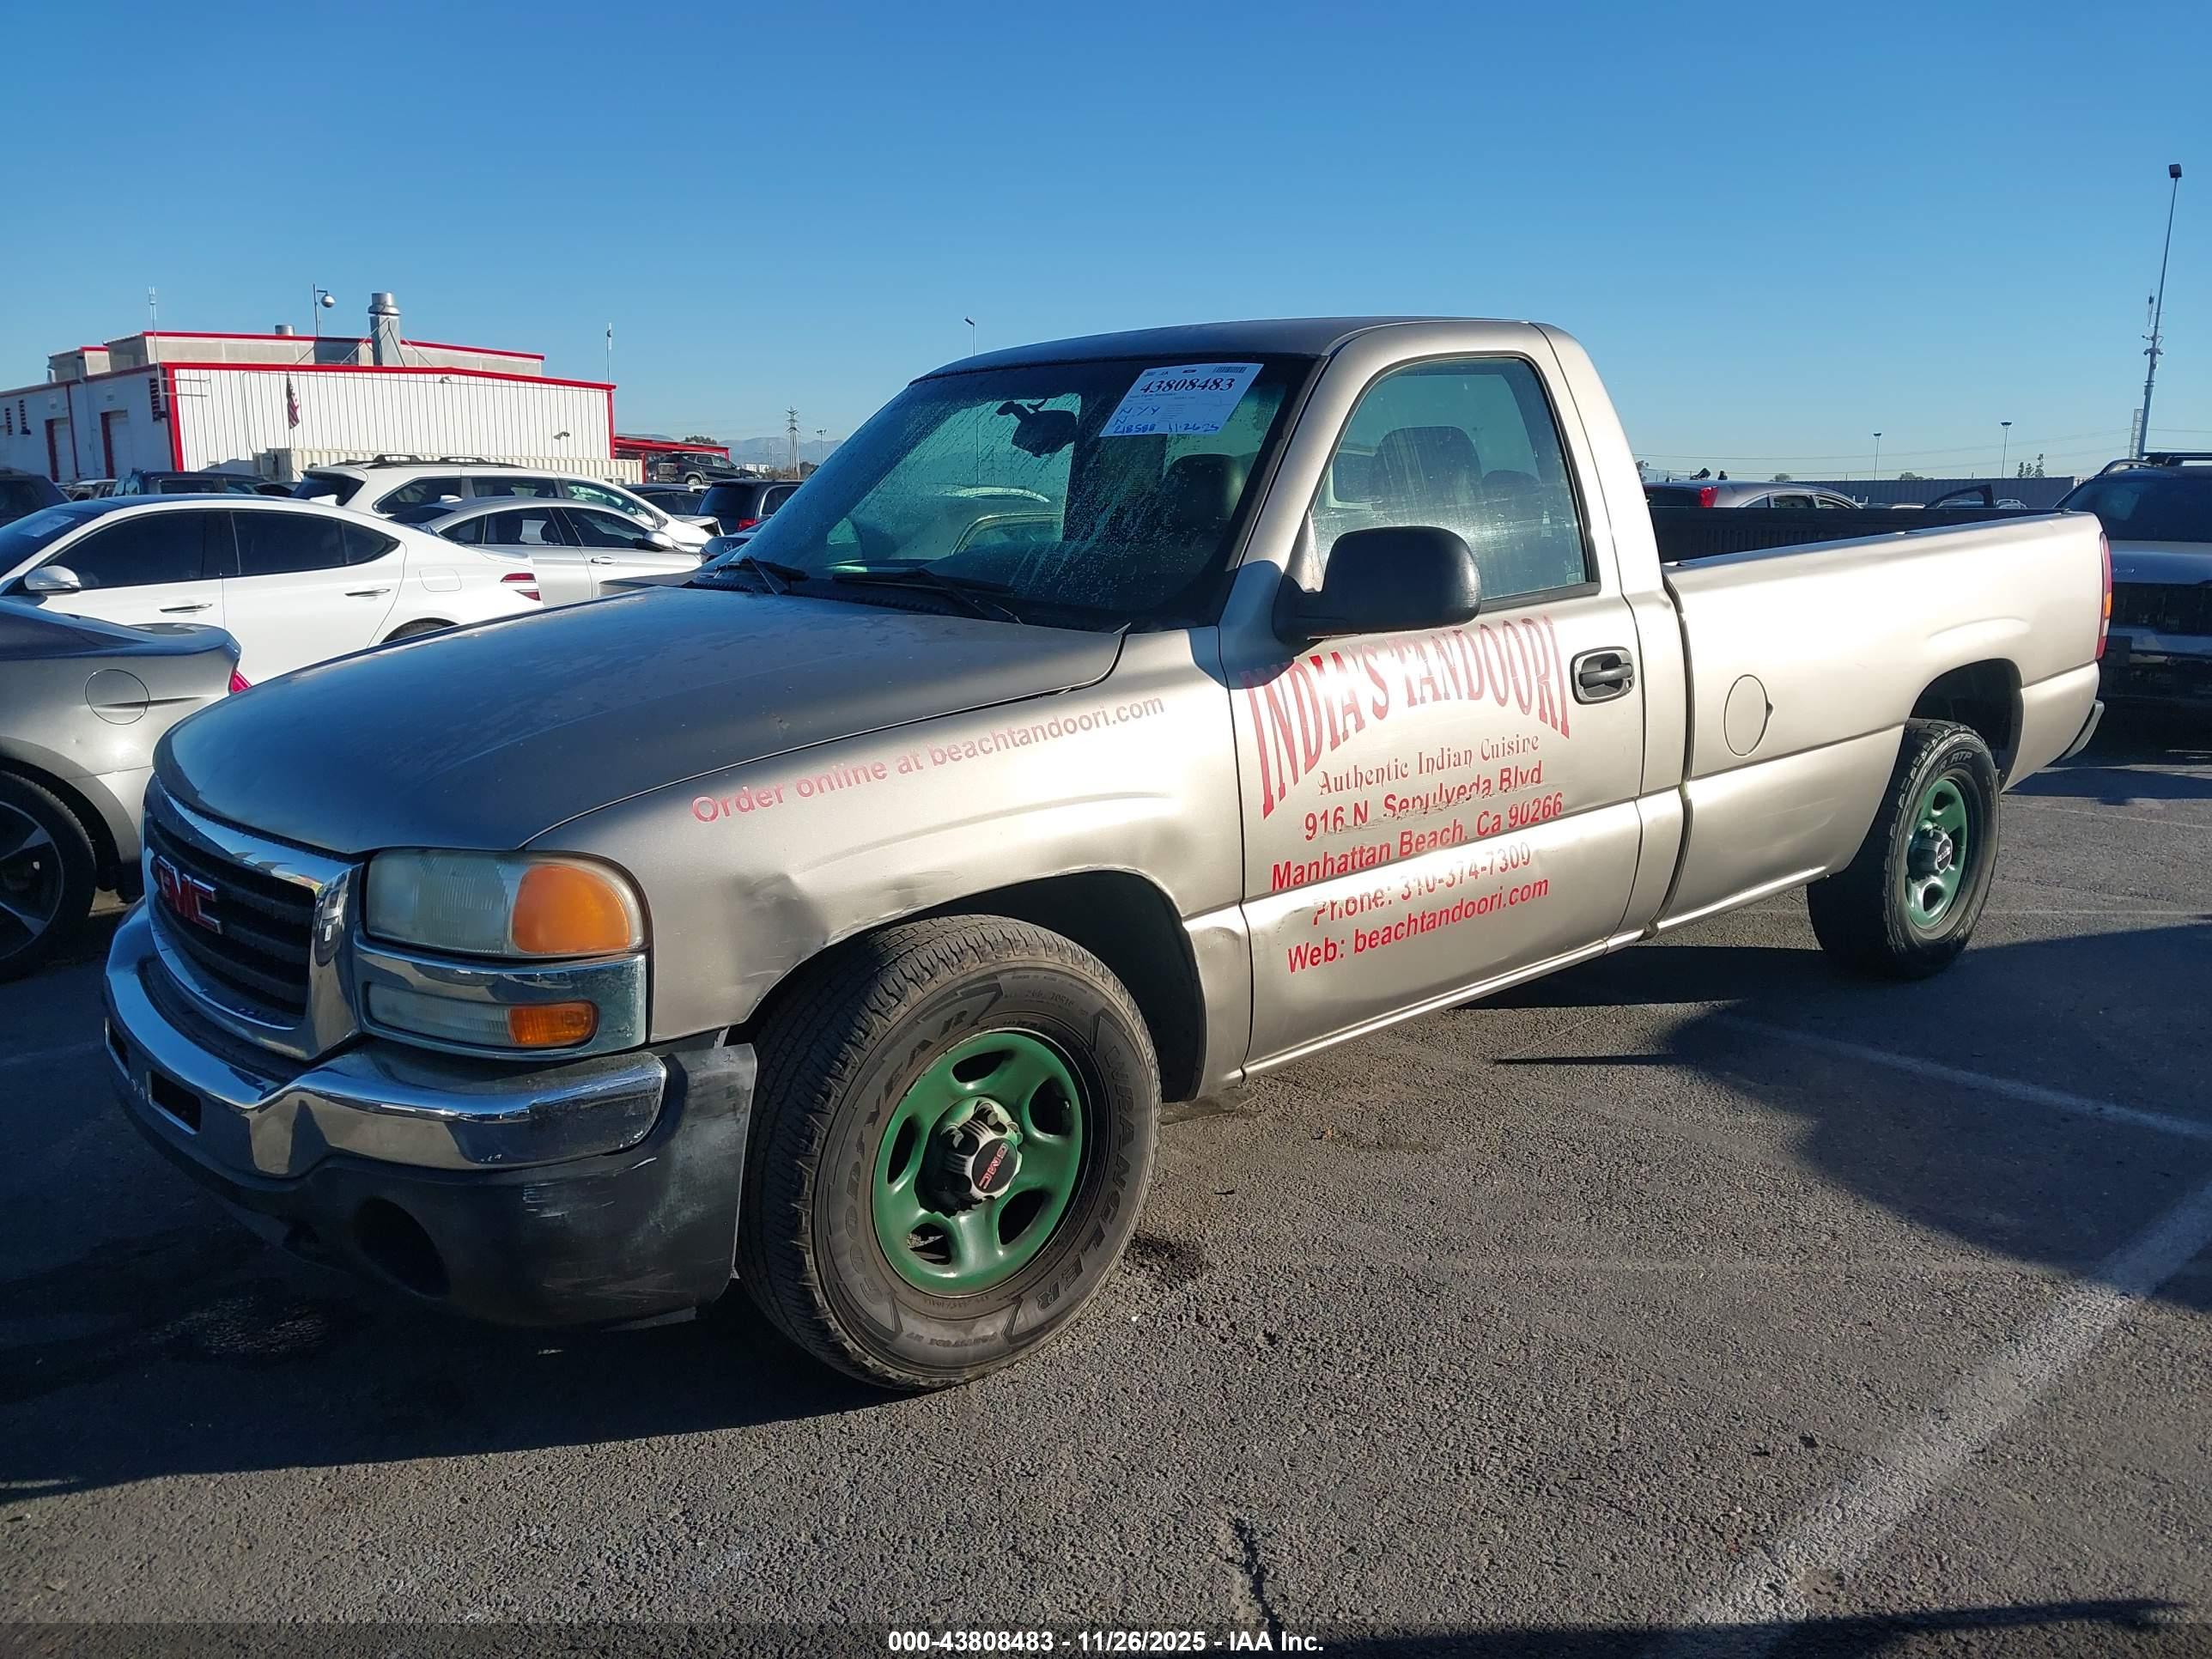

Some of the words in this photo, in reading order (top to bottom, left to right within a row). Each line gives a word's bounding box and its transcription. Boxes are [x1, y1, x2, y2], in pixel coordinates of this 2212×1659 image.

[1139, 377, 1235, 393] 43808483
[690, 785, 784, 823] Order
[796, 758, 888, 799] online
[898, 750, 922, 775] at
[931, 694, 1165, 767] beachtandoori.com
[1240, 645, 1389, 819] INDIA'S
[1383, 617, 1570, 739] TANDOORI
[1304, 805, 1345, 841] 916
[1499, 759, 1542, 793] Blvd
[1318, 758, 1409, 796] Authentic
[1418, 745, 1473, 776] Indian
[1480, 734, 1540, 763] Cuisine
[1272, 840, 1391, 891] Manhattan
[1477, 810, 1501, 836] Ca
[1508, 792, 1564, 829] 90266
[157, 855, 224, 935] GMC
[1313, 885, 1393, 926] Phone:
[1401, 842, 1532, 902] 310-374-7300
[1288, 937, 1345, 974] Web:
[1353, 878, 1549, 953] beachtandoori.com
[979, 1142, 1009, 1189] GMC
